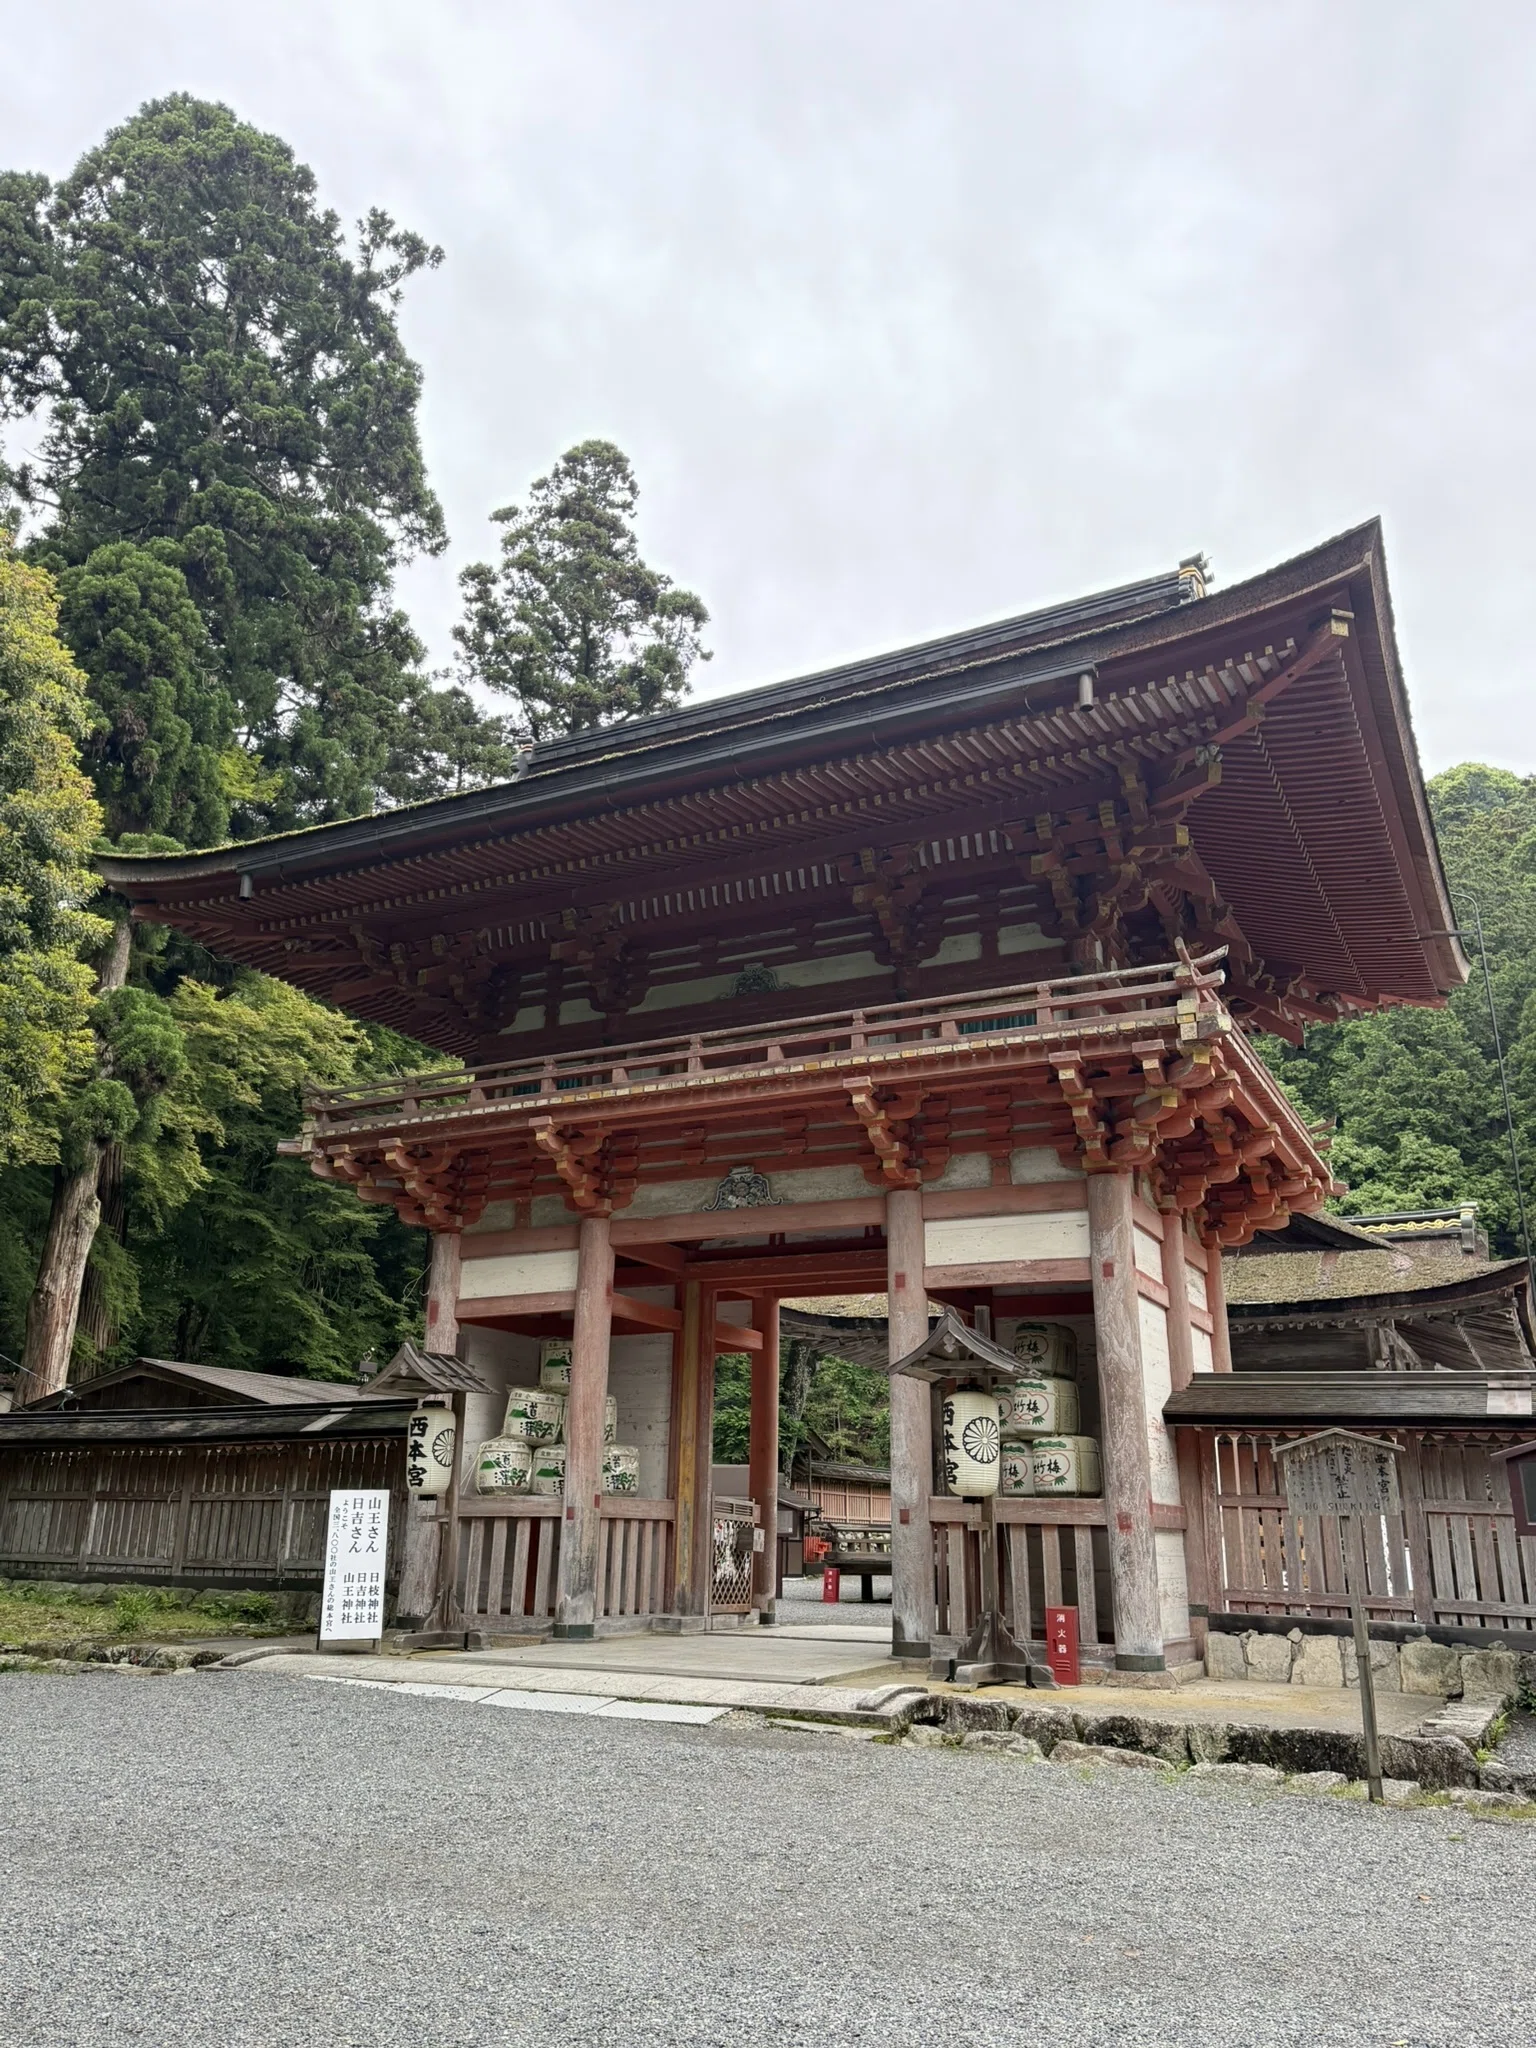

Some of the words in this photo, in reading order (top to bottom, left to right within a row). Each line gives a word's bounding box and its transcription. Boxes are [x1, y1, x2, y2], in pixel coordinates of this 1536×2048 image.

[408, 1416, 429, 1487] 西本宮
[1334, 1475, 1351, 1499] 禁止
[340, 1499, 349, 1530] ようこそ
[348, 1497, 364, 1554] 日吉さん
[365, 1497, 382, 1553] 山王さん
[341, 1572, 355, 1624] 山王神社
[354, 1572, 367, 1624] 日吉神社
[367, 1572, 380, 1623] 日枝神社
[1056, 1613, 1067, 1654] 消火器
